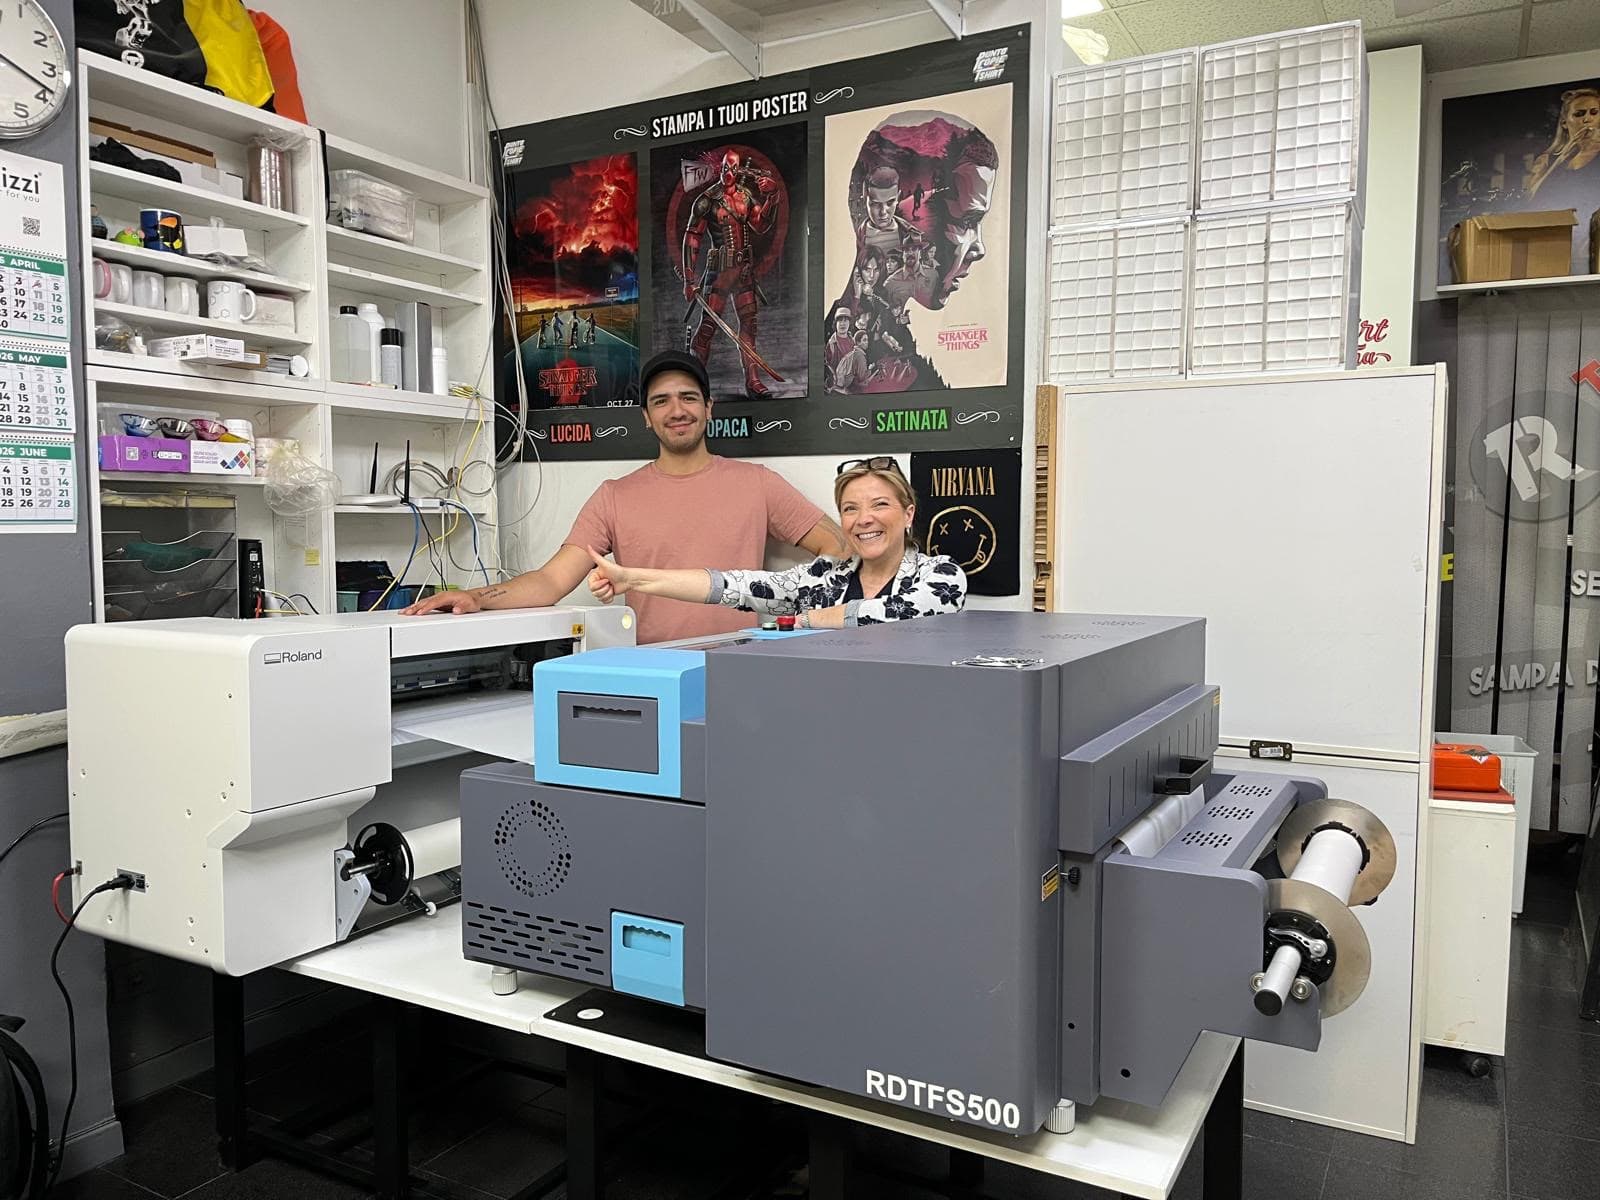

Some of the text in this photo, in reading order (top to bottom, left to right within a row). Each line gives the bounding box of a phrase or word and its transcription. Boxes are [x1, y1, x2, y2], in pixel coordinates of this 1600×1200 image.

[33, 30, 48, 49] 2
[41, 61, 57, 79] 3
[34, 88, 49, 105] 4
[13, 102, 29, 119] 5
[652, 91, 808, 138] STAMPA I TUOI POSTER
[10, 258, 41, 270] APRIL
[14, 288, 26, 296] 10
[52, 293, 62, 302] 12
[14, 299, 26, 308] 17
[52, 305, 63, 313] 19
[13, 311, 28, 319] 24
[32, 313, 46, 322] 25
[51, 316, 64, 324] 26
[938, 329, 988, 345] STRANGER
[1359, 318, 1389, 343] rt
[946, 340, 980, 351] THINGS
[18, 354, 41, 364] MAY
[55, 376, 62, 384] 3
[19, 383, 26, 391] 8
[54, 386, 66, 395] 10
[17, 394, 29, 402] 15
[55, 397, 66, 405] 17
[607, 400, 622, 408] OCT
[17, 405, 31, 413] 22
[54, 408, 68, 416] 24
[17, 416, 32, 424] 29
[56, 419, 67, 427] 31
[876, 408, 948, 432] SATINATA
[550, 423, 592, 442] LUCIDA
[706, 417, 749, 438] OPACA
[20, 447, 48, 457] JUNE
[3, 466, 11, 474] 4
[22, 467, 29, 475] 5
[2, 477, 11, 485] 11
[20, 478, 32, 486] 12
[58, 479, 69, 487] 14
[930, 466, 997, 497] NIRVANA
[1, 488, 13, 497] 18
[20, 488, 32, 497] 19
[38, 489, 52, 497] 20
[1, 499, 15, 508] 25
[20, 500, 34, 508] 26
[57, 500, 71, 508] 28
[281, 648, 323, 664] Roland
[866, 1069, 1021, 1130] RDTFS500
